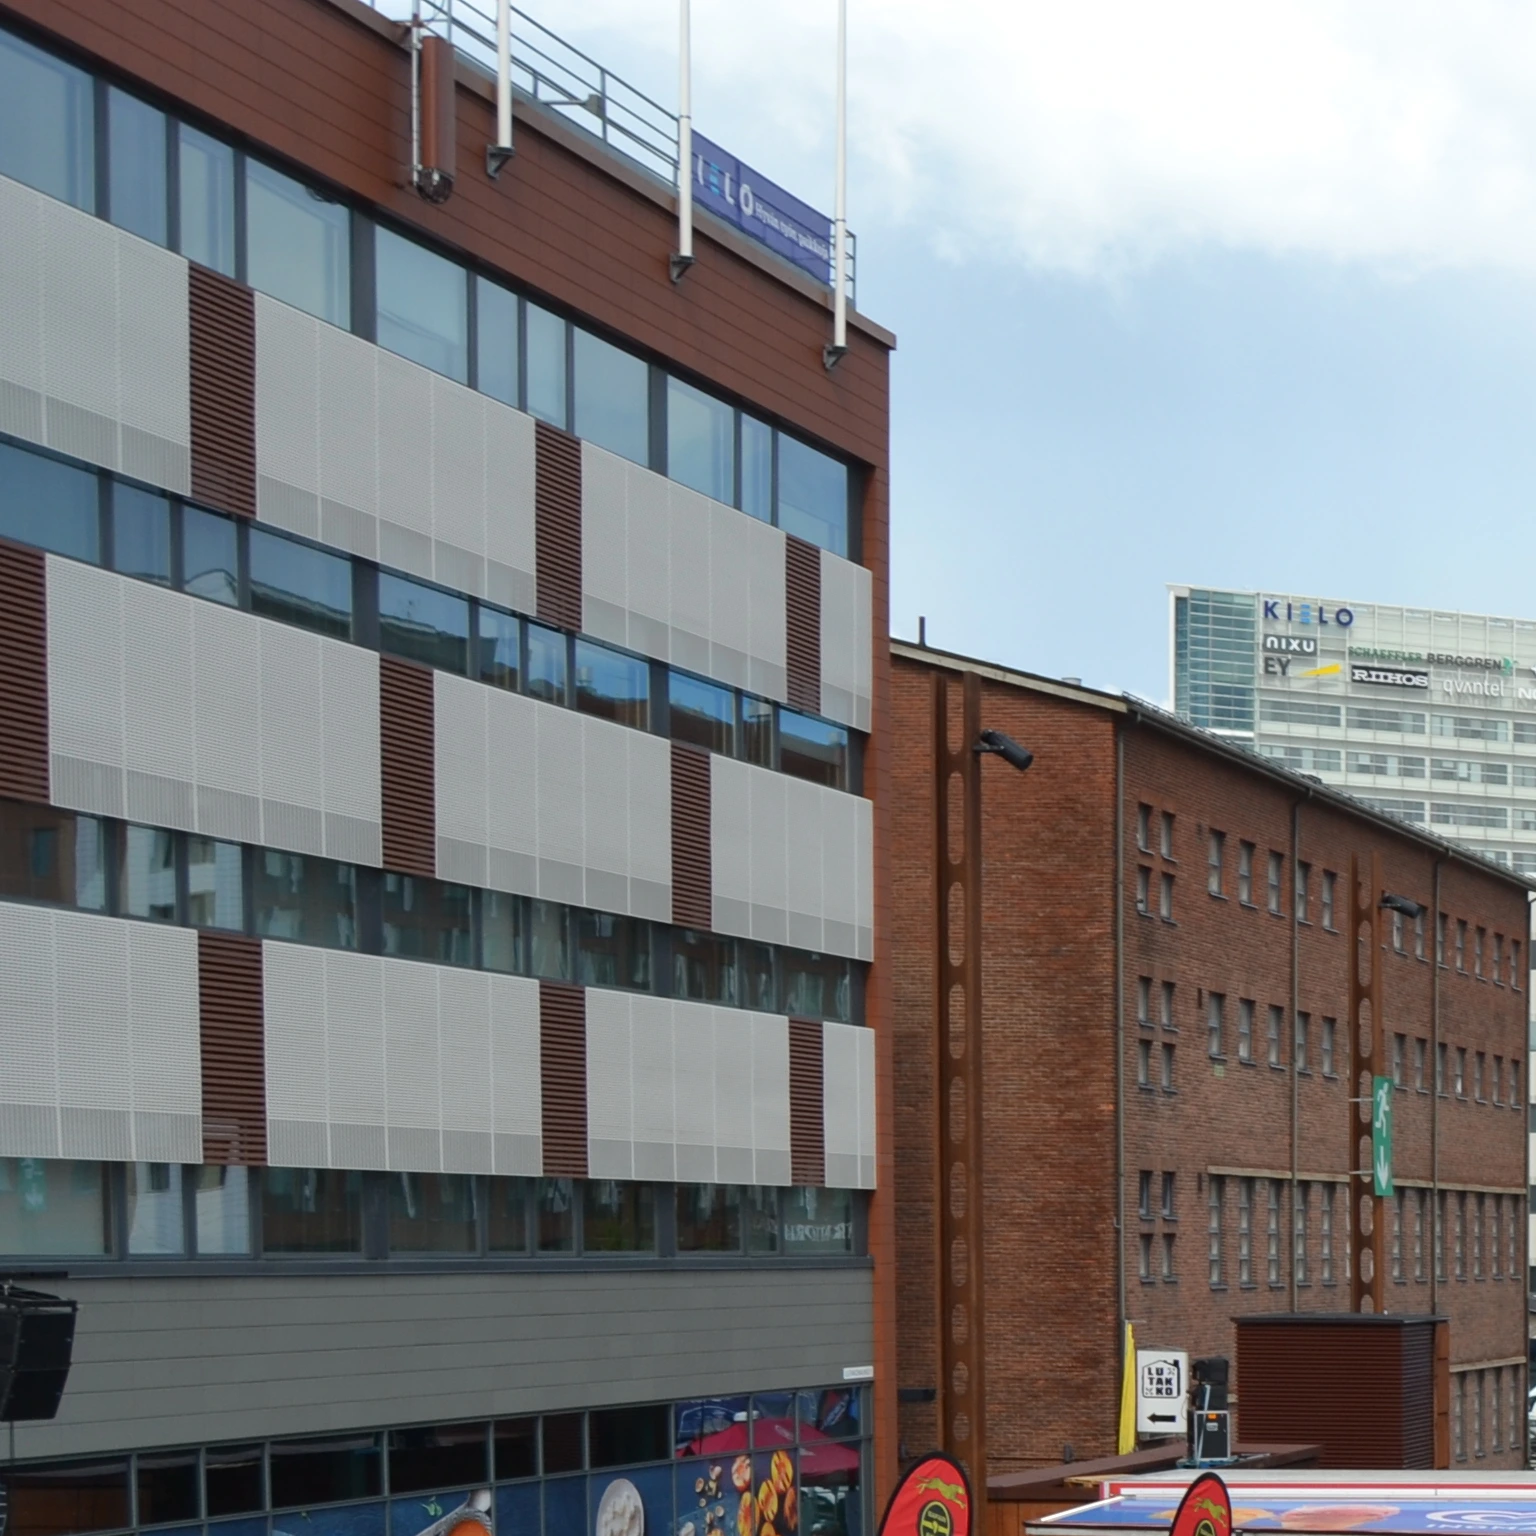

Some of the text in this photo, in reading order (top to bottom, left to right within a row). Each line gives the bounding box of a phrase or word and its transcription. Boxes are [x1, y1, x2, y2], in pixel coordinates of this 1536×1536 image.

[697, 154, 754, 216] IELO
[1264, 601, 1354, 627] KIELO
[1349, 646, 1422, 662] SCHAEFFLER
[1427, 653, 1502, 671] BERGGREN
[1264, 657, 1291, 676] EY
